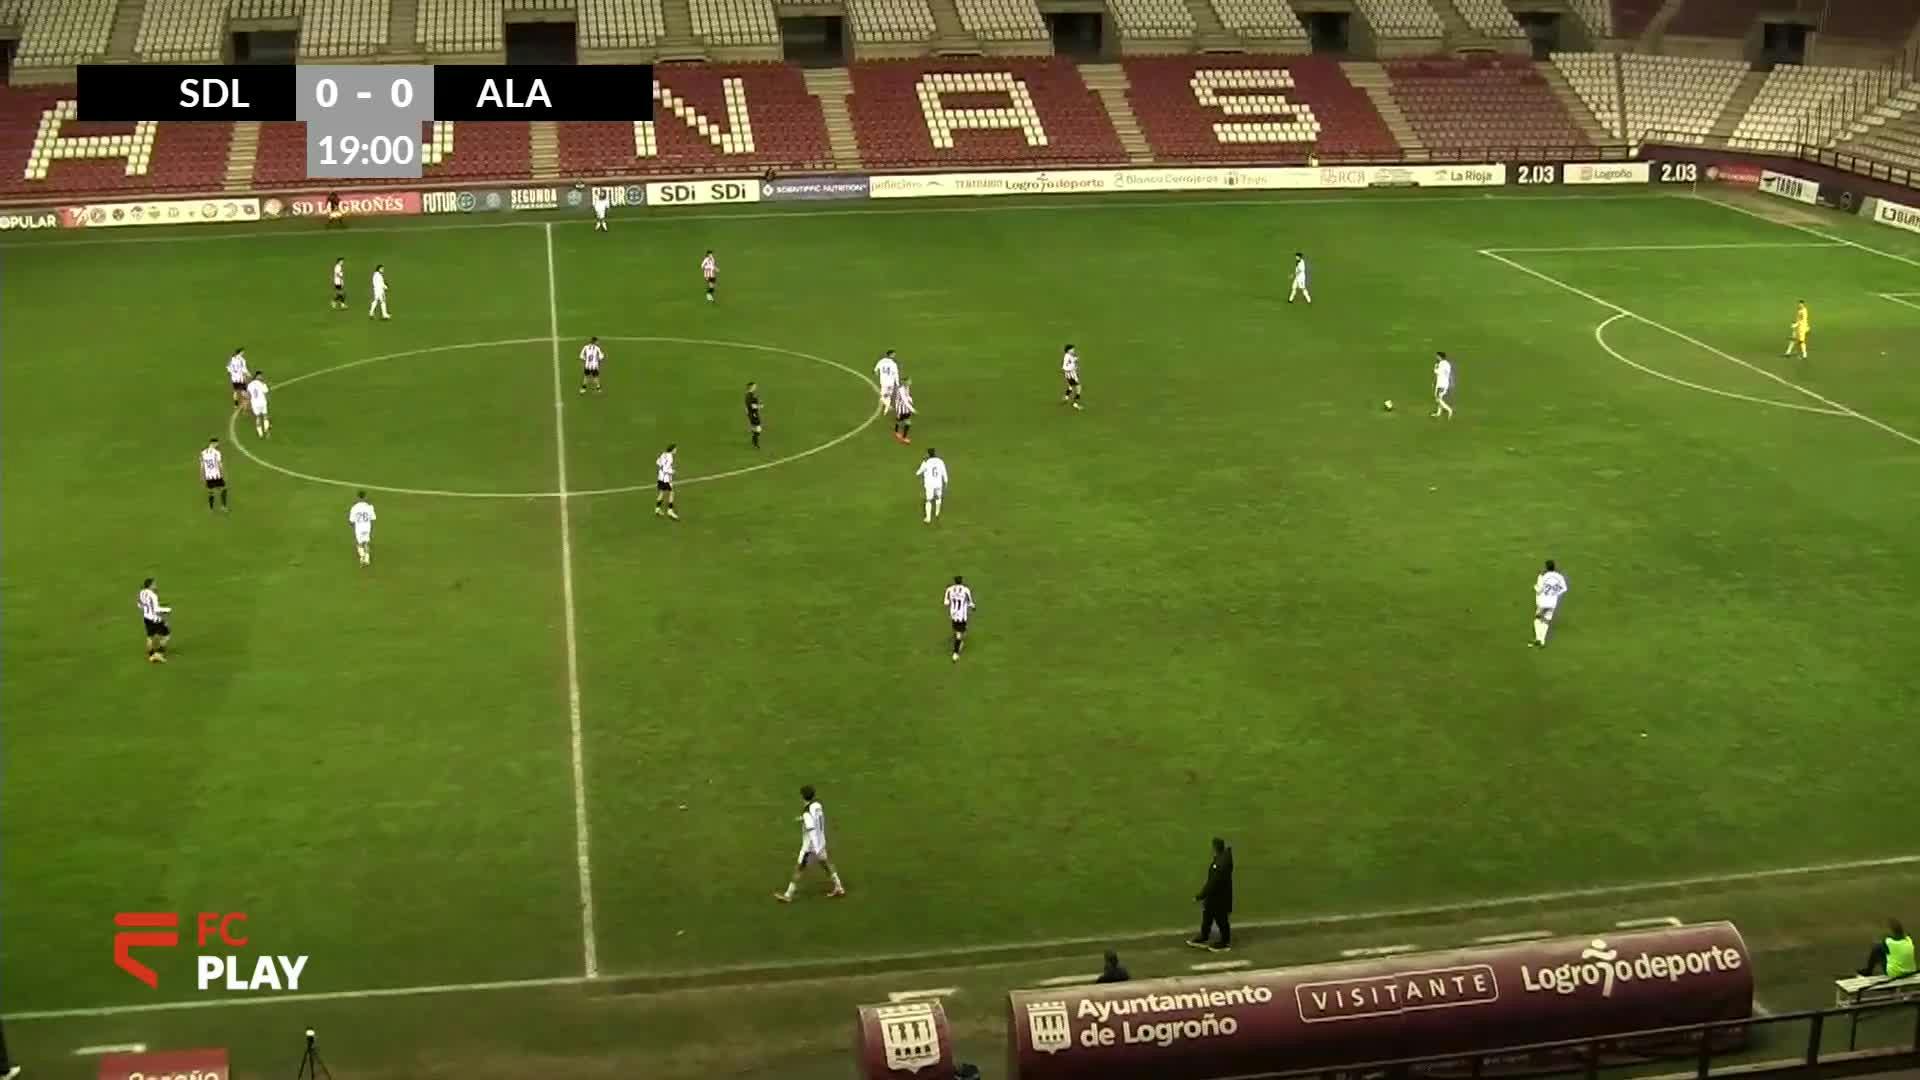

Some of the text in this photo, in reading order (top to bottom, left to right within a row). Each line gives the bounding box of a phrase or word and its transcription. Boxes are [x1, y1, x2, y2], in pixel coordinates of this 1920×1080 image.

[1517, 165, 1555, 184] 2.03
[1660, 163, 1697, 182] 2.03
[511, 188, 558, 204] SEGUNDA
[660, 182, 747, 202] SDi SDi
[291, 200, 314, 216] SD
[1311, 974, 1488, 1011] VISITANTE
[1076, 983, 1273, 1023] Ayuntamiento
[1079, 1012, 1238, 1048] de Logroño
